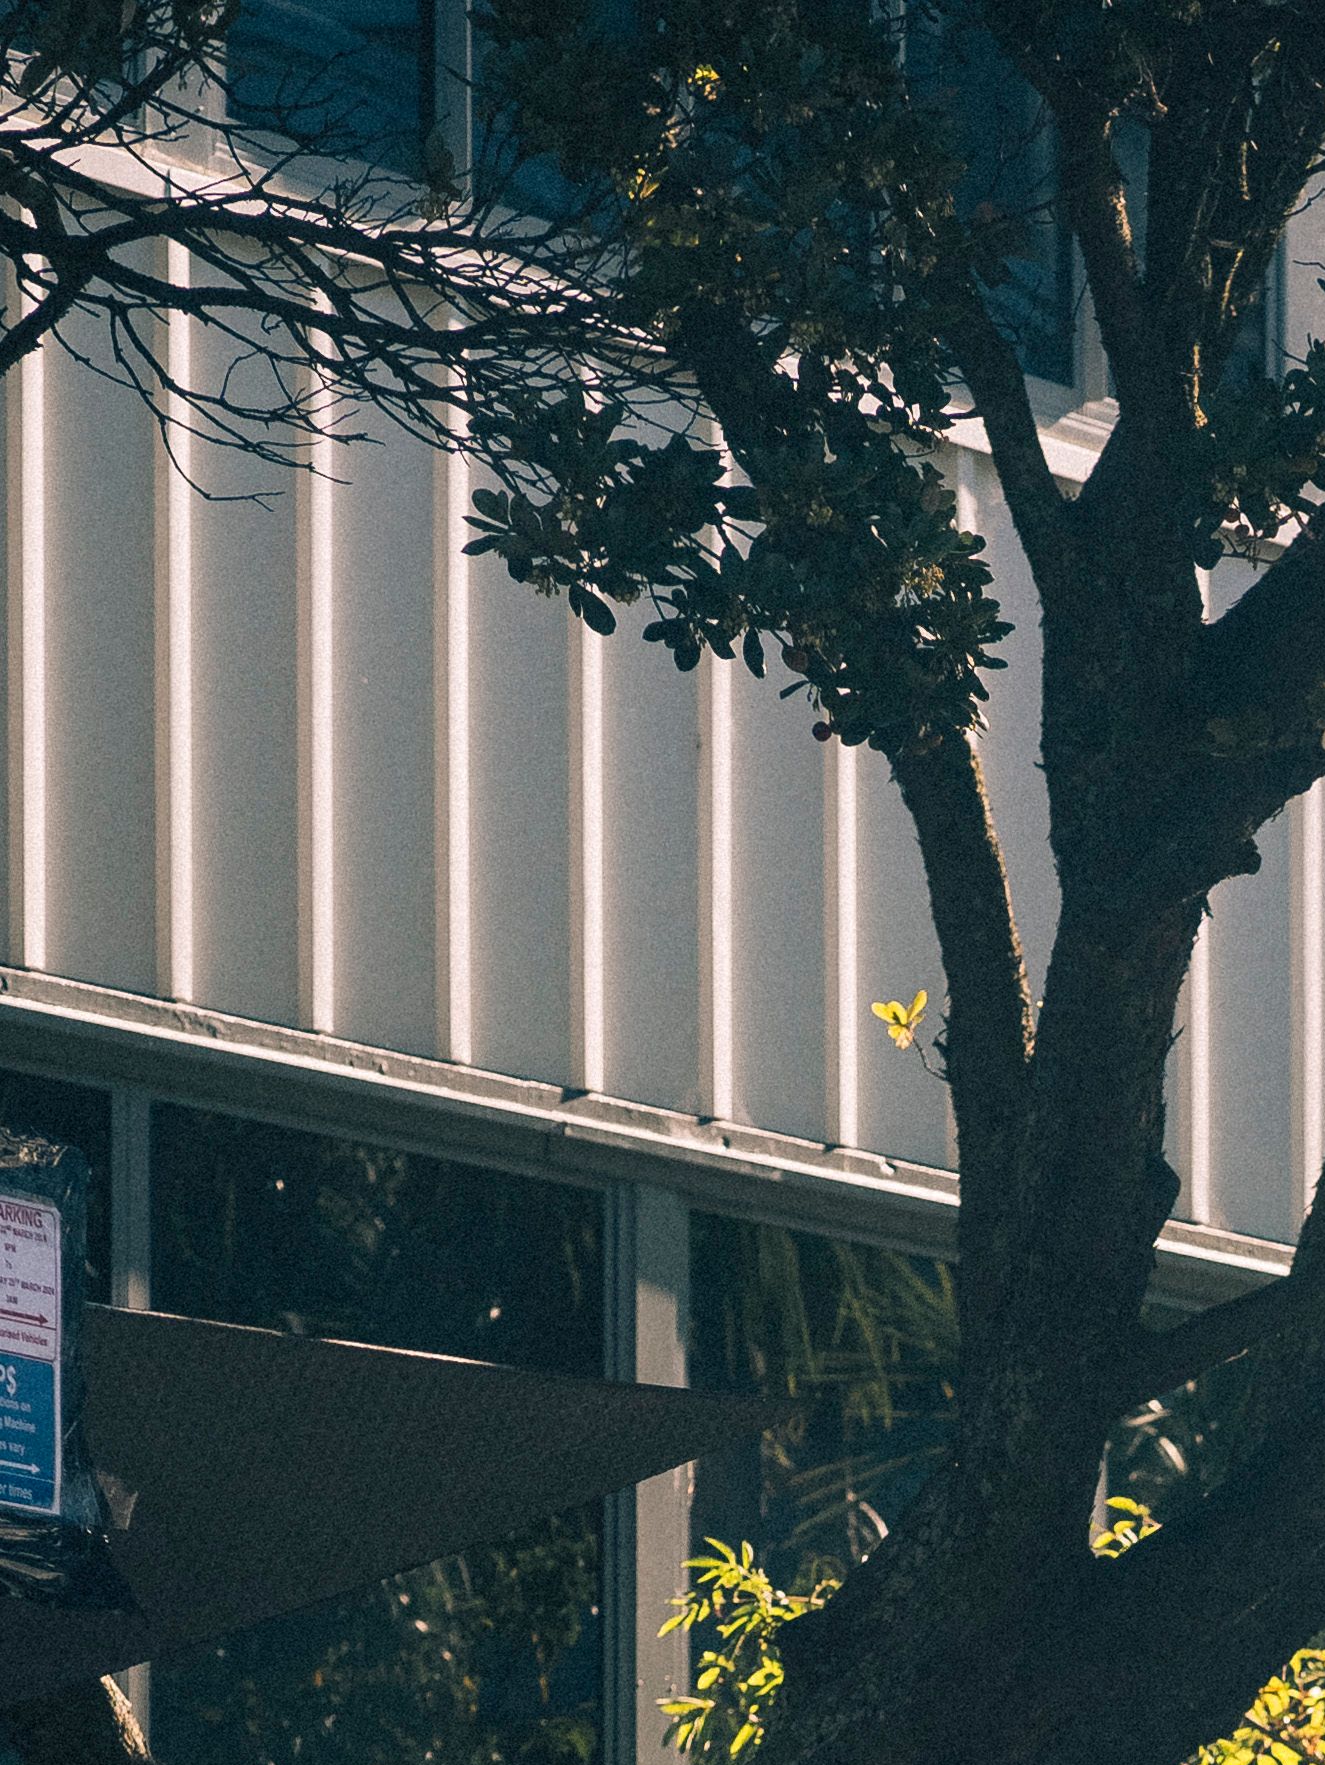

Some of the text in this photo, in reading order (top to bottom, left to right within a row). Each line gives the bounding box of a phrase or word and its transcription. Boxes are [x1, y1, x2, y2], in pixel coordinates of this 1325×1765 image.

[21, 1281, 41, 1293] MARCH
[21, 1331, 48, 1347] Vehicles
[4, 1415, 36, 1433] Machine
[8, 1441, 25, 1457] vary
[8, 1484, 33, 1500] times
